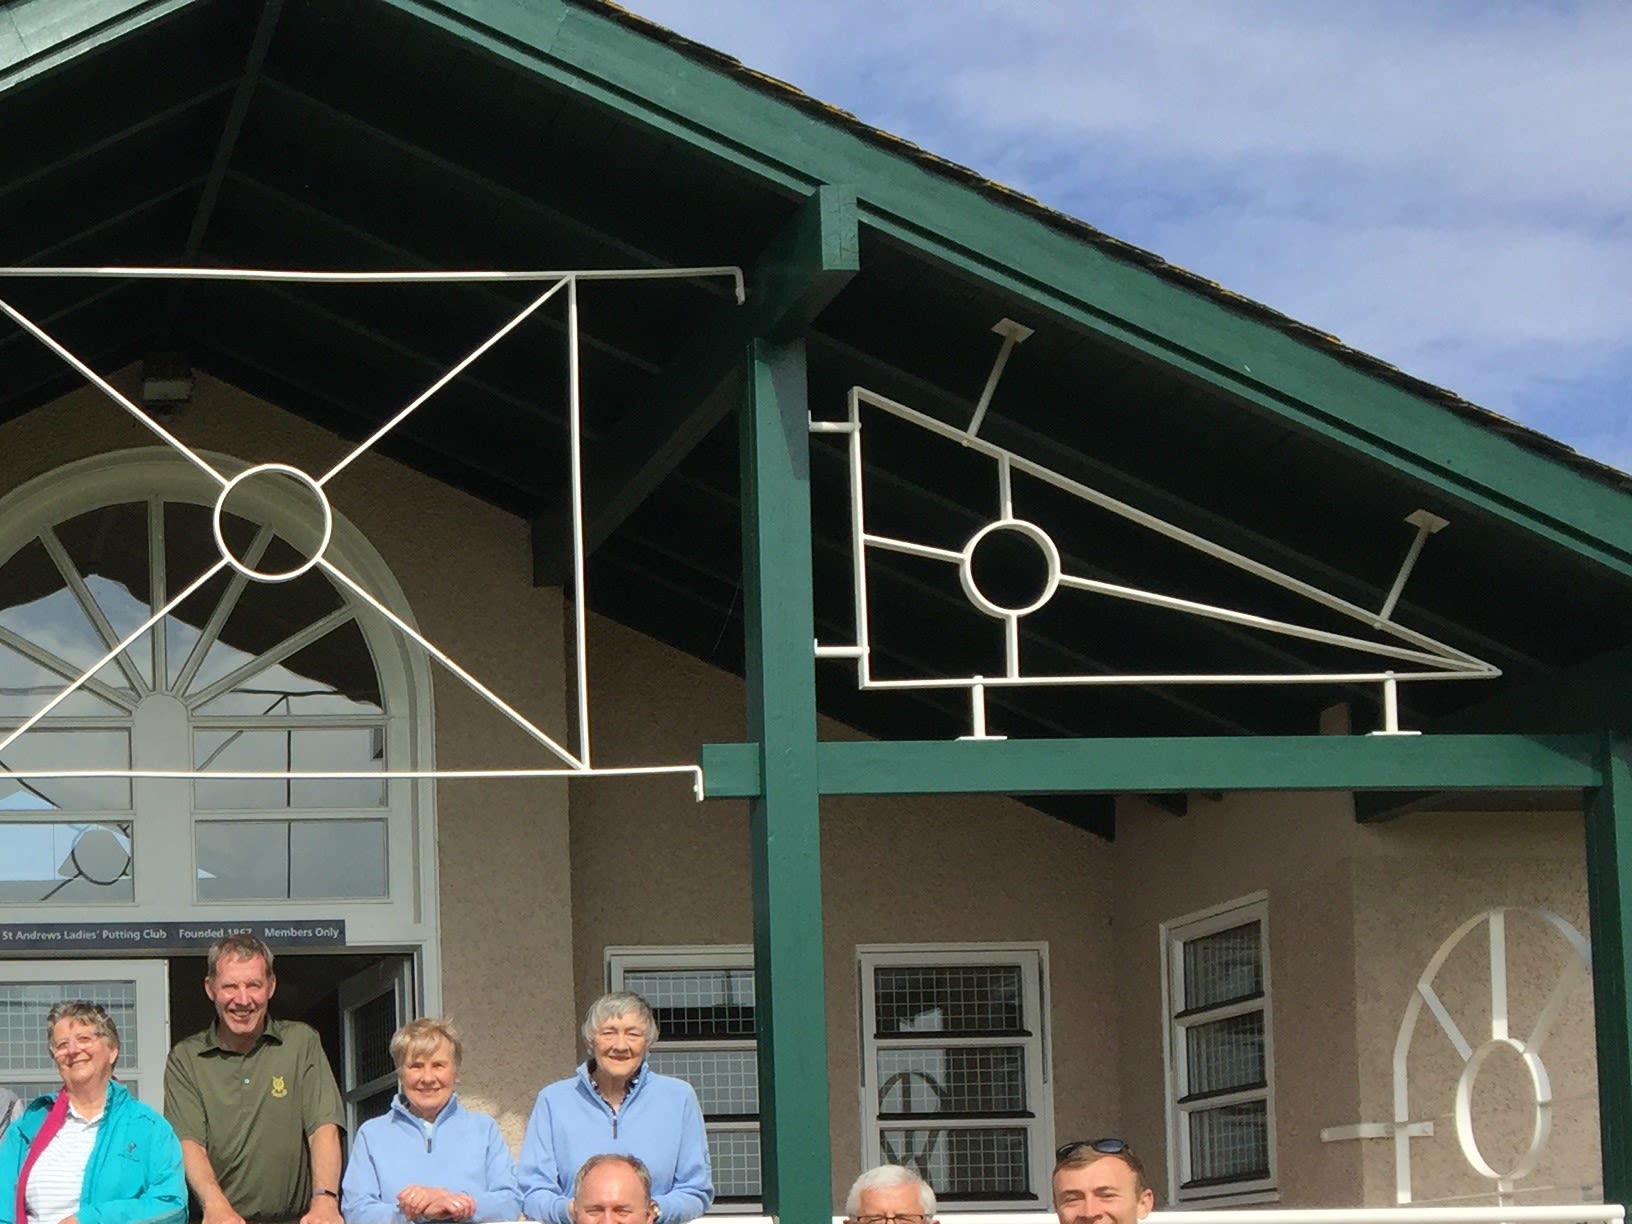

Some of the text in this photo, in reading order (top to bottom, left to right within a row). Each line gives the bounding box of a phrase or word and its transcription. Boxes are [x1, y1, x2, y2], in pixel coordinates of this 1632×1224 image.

[2, 930, 13, 940] St
[16, 930, 61, 940] Andrews
[102, 929, 140, 942] Putting
[143, 928, 166, 939] Club
[179, 928, 224, 938] Founded
[265, 927, 312, 938] Members
[316, 927, 339, 940] Only
